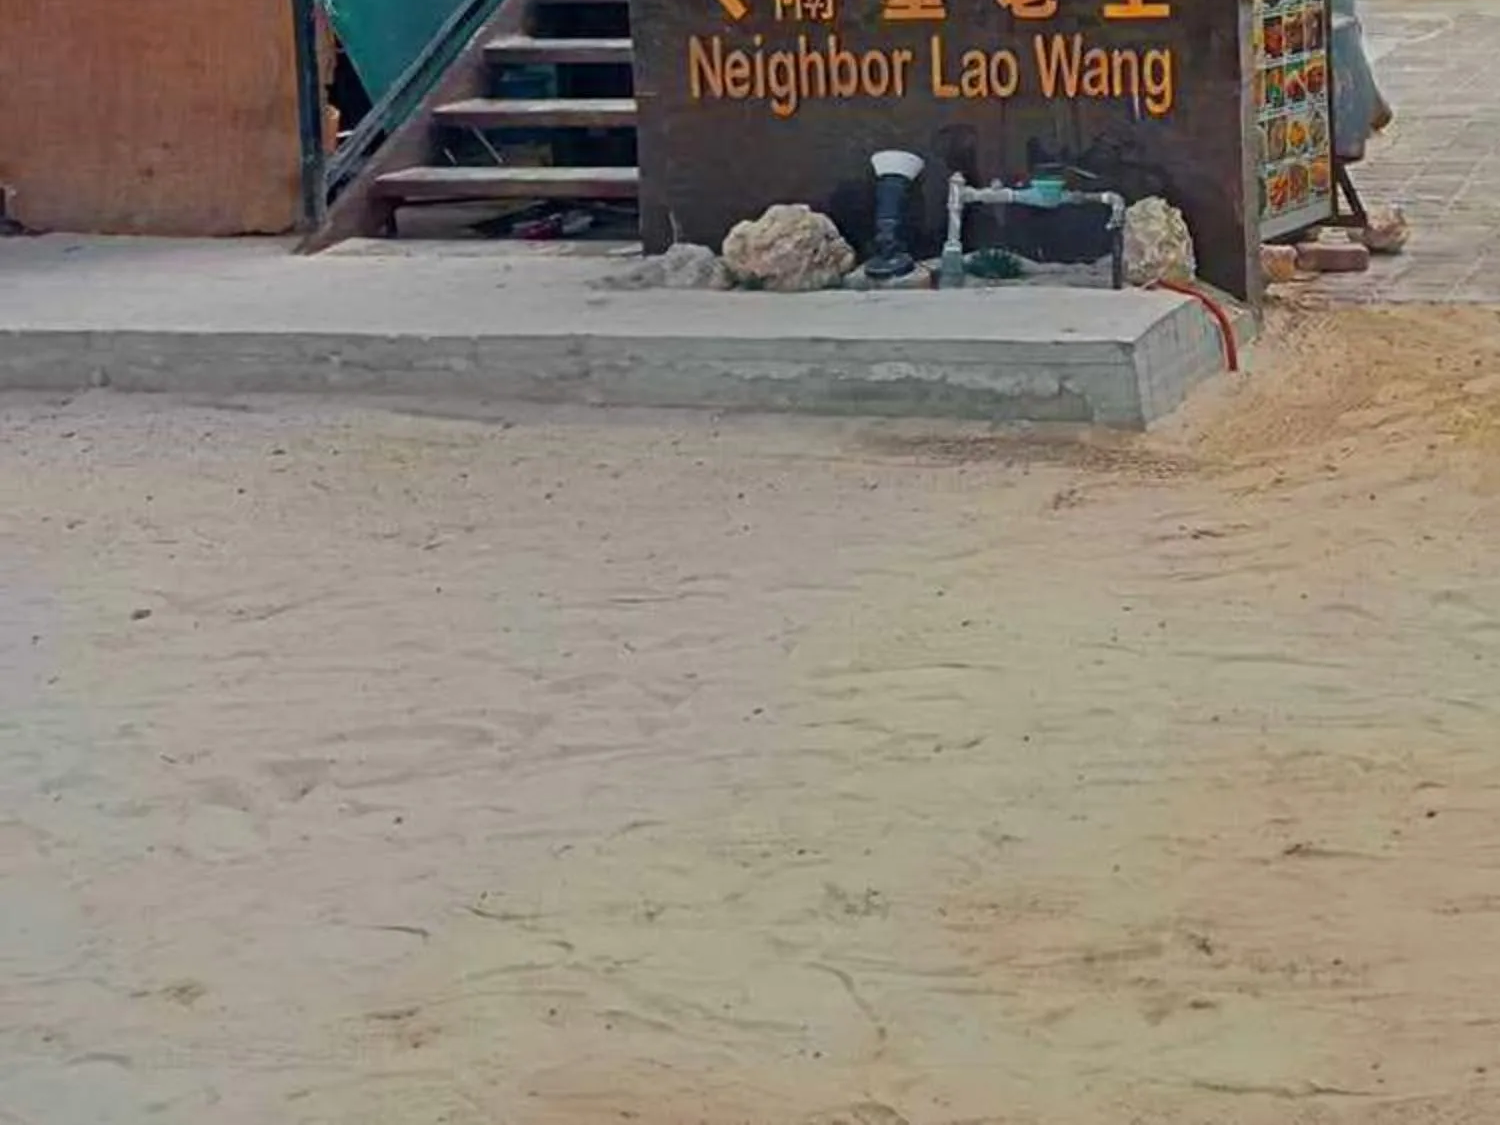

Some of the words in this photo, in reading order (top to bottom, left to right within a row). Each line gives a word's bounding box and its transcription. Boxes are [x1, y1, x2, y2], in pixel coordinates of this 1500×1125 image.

[689, 35, 911, 115] Neighbor
[931, 36, 1018, 97] Lao
[1034, 37, 1174, 116] Wang
